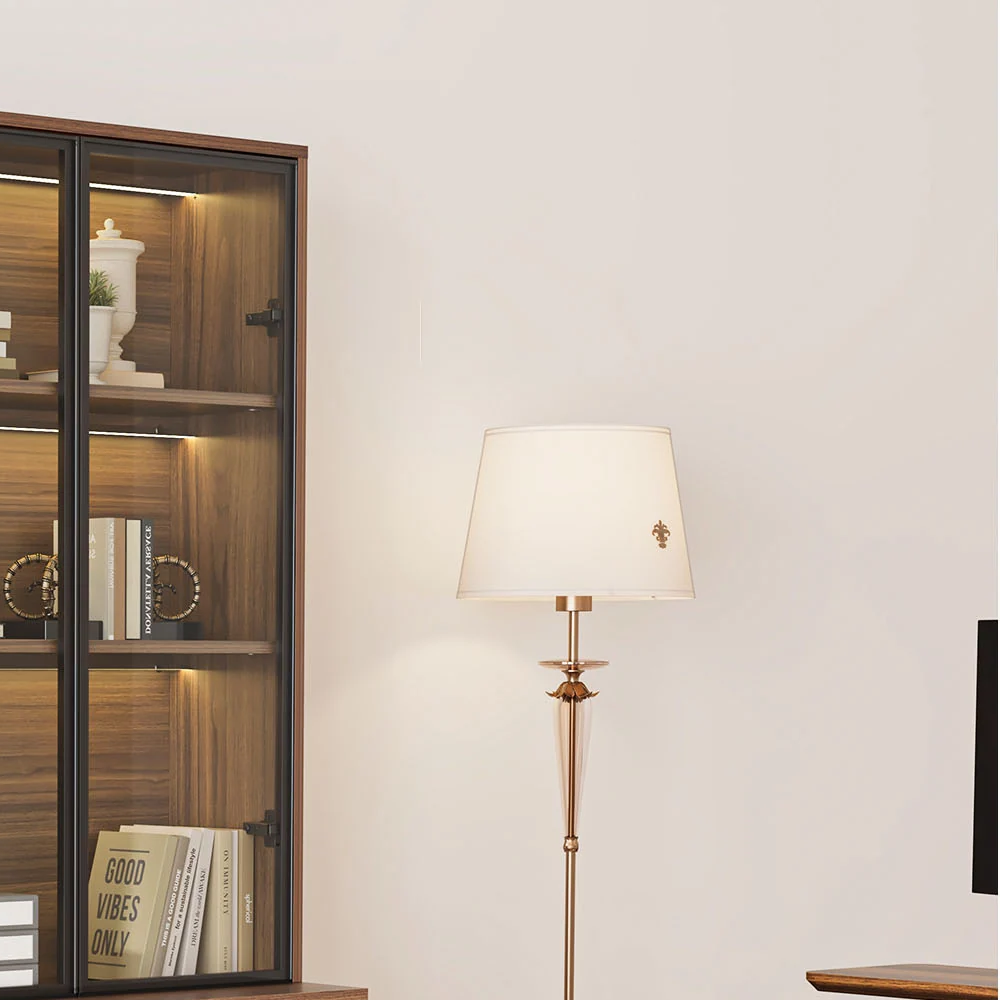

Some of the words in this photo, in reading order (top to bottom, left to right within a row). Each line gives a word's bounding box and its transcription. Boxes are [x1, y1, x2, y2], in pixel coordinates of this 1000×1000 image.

[223, 850, 230, 862] ON
[105, 857, 146, 885] GOOD
[174, 920, 182, 930] for
[179, 874, 191, 913] sustainable
[187, 847, 197, 874] lifestyle
[96, 893, 141, 922] VIBES
[91, 929, 130, 957] ONLY
